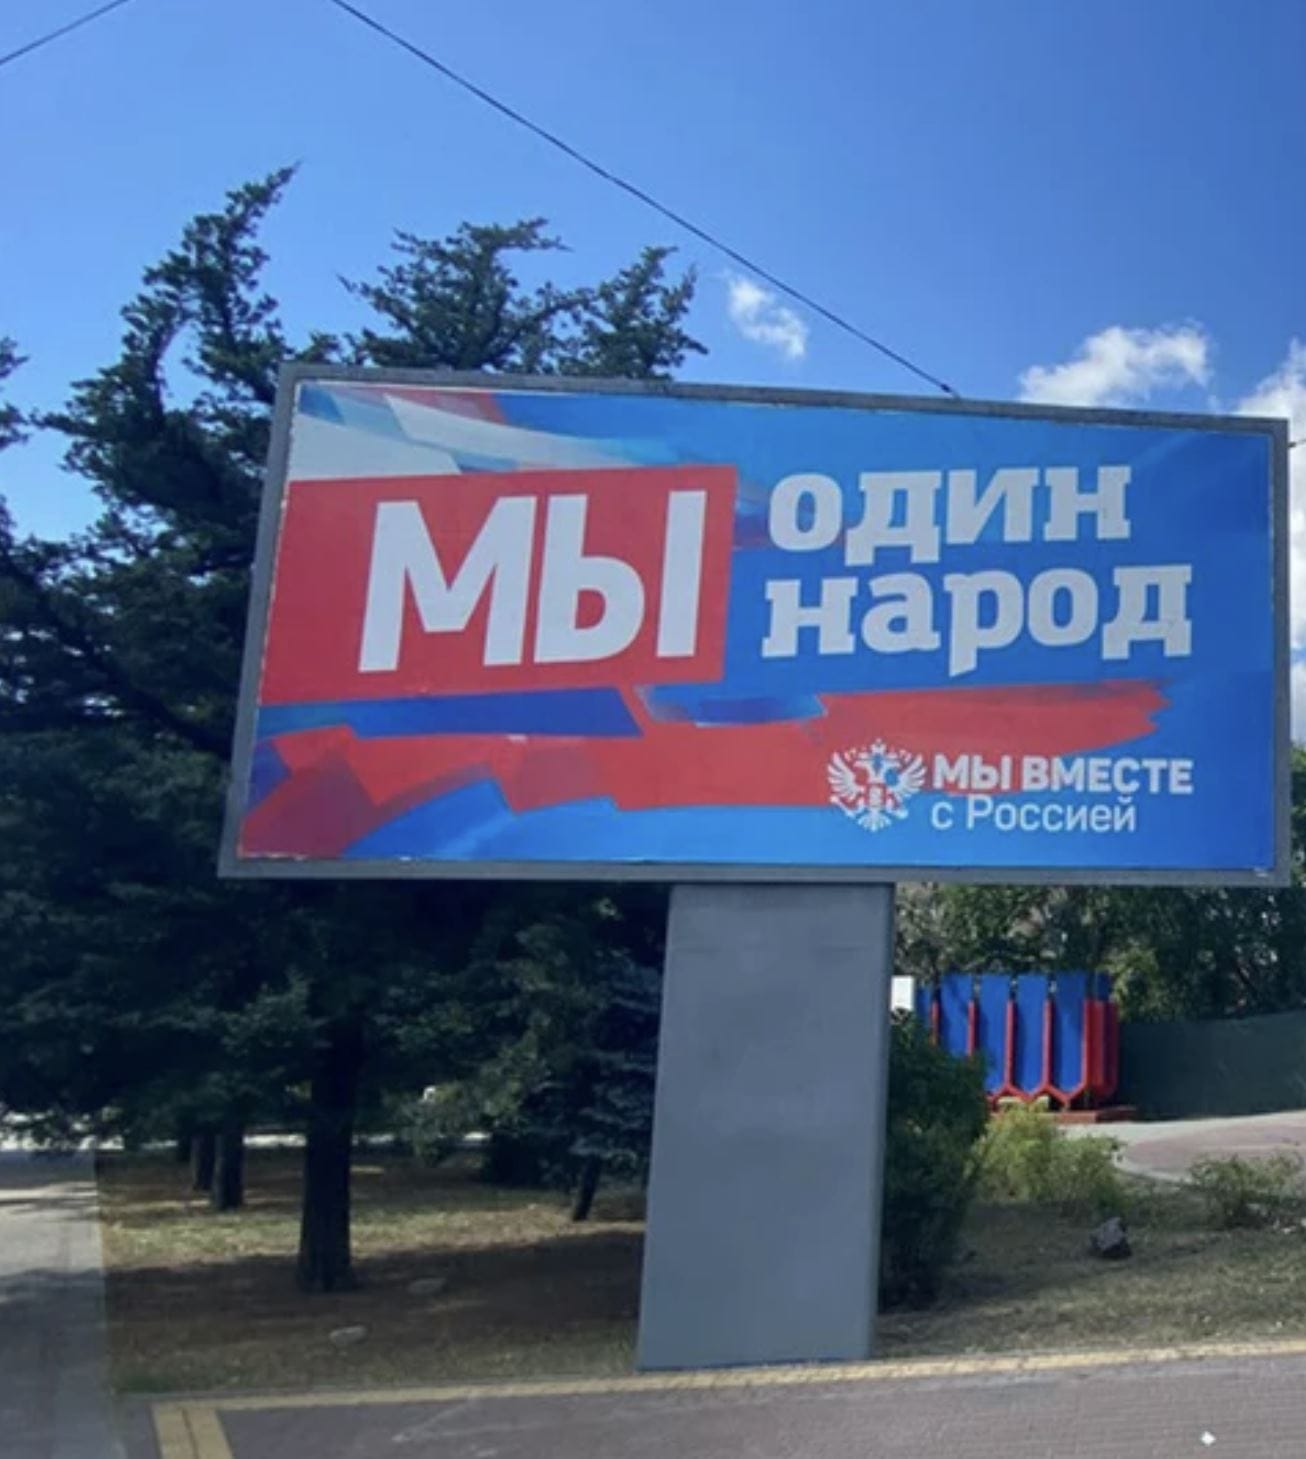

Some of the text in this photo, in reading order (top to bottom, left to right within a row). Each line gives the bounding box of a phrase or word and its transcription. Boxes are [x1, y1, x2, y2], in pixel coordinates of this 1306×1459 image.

[769, 468, 1129, 566] один
[358, 490, 708, 673] МЫ
[762, 566, 1190, 676] народ
[931, 793, 1136, 833] с Россией
[932, 753, 1193, 794] МЫ ВМЕСТЕ
